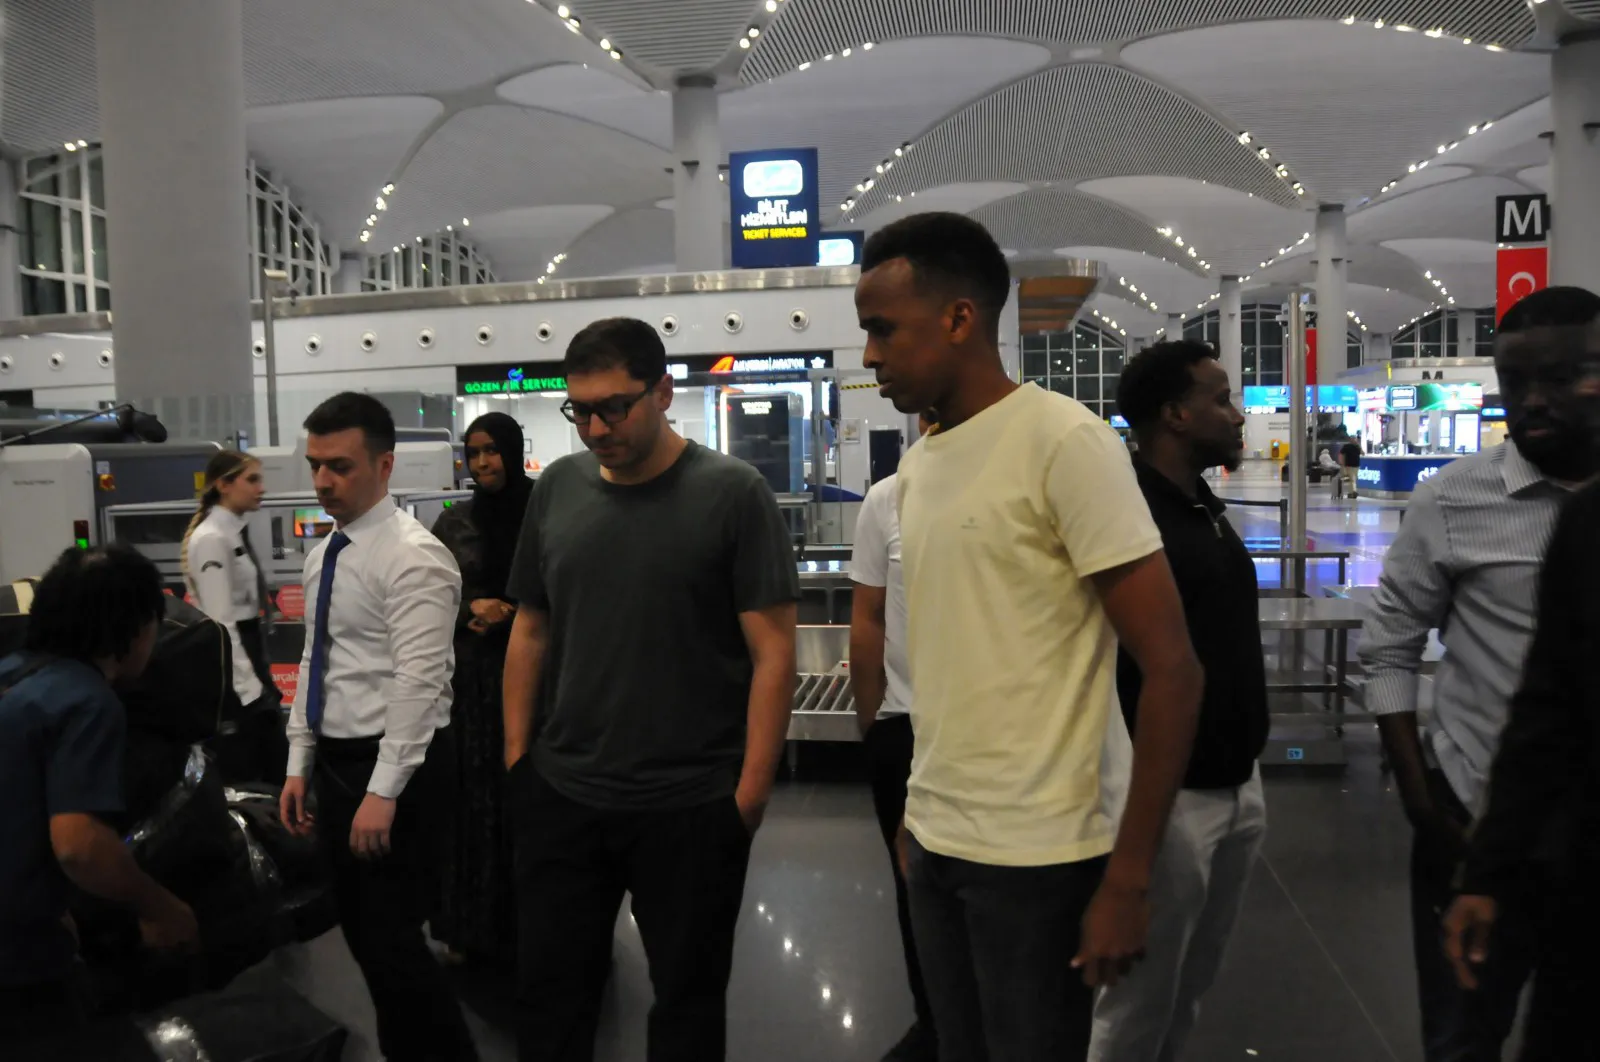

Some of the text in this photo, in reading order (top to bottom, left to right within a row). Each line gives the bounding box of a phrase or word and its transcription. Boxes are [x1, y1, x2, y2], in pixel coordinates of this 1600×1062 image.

[1502, 199, 1542, 236] M
[743, 227, 807, 240] TICKET SERVICES
[502, 380, 520, 391] AIR
